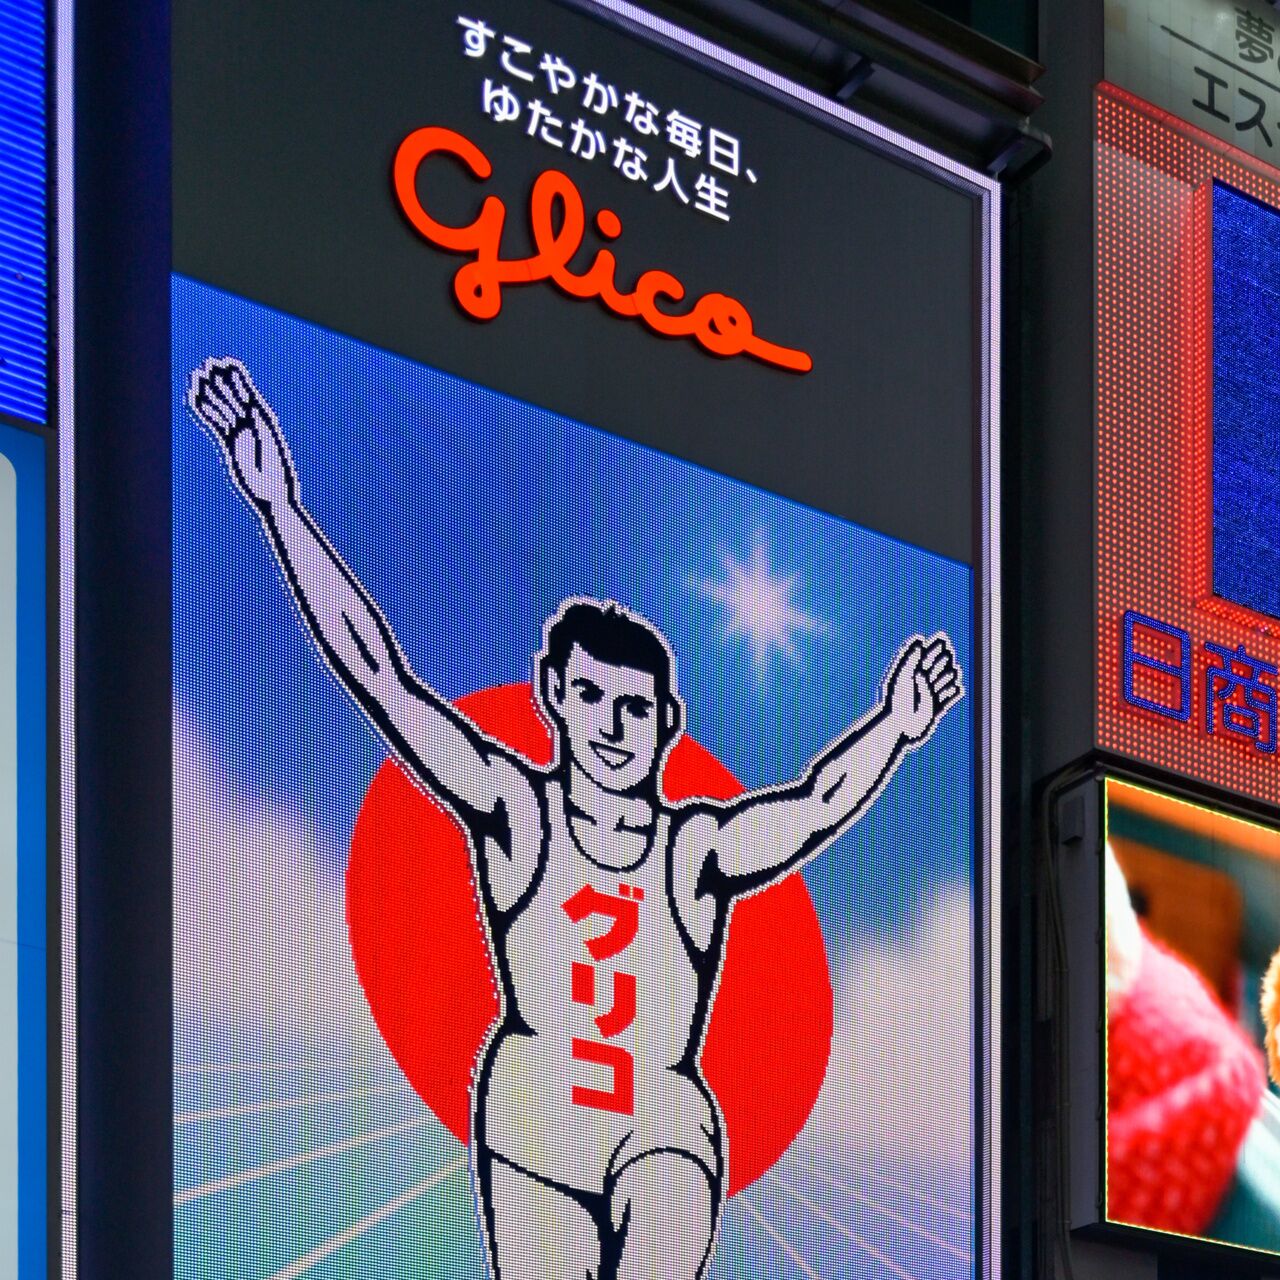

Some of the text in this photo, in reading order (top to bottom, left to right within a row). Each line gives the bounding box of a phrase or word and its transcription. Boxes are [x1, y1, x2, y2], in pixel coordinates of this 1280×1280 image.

[457, 15, 758, 184] すこやかな毎日、
[482, 79, 731, 221] ゆたかな人生
[393, 126, 813, 373] Glico
[561, 883, 645, 1116] グリコ
